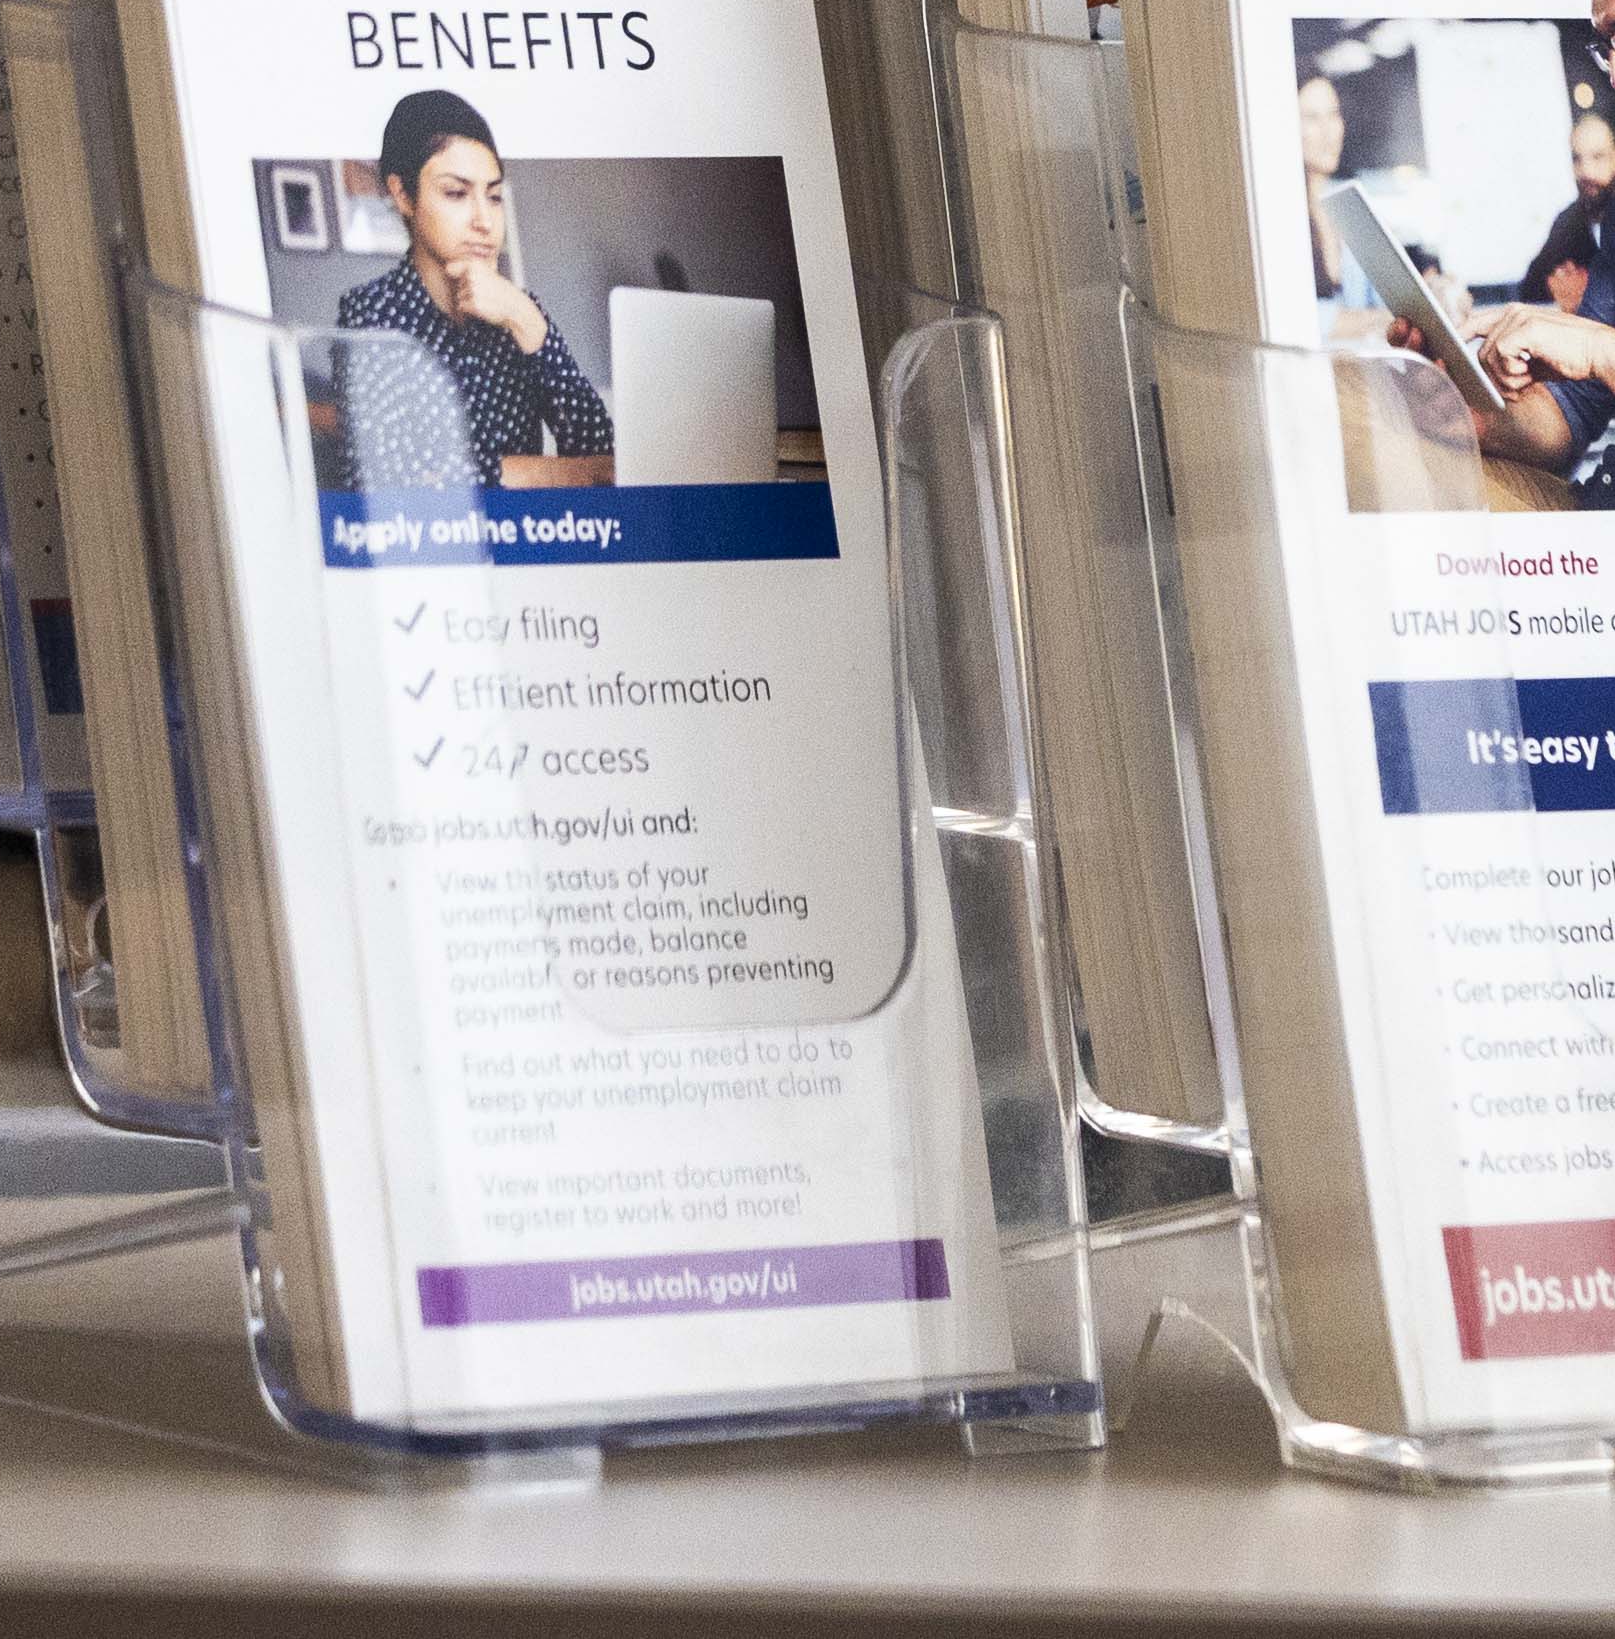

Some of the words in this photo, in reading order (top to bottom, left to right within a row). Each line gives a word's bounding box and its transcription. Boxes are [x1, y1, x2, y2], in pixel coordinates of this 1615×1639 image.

[347, 11, 656, 71] BENEFITS
[430, 510, 517, 544] onlne
[523, 510, 623, 550] today:
[1560, 549, 1599, 577] the
[521, 606, 600, 649] filing
[1391, 610, 1459, 637] UTAH
[1466, 609, 1522, 636] JOS
[1528, 607, 1604, 635] mobile
[587, 670, 772, 708] information
[543, 744, 650, 775] access
[1466, 727, 1518, 765] It's
[1525, 734, 1600, 771] easy
[434, 807, 634, 848] jobs.uth.gov/ui
[642, 808, 698, 836] and:
[504, 867, 540, 893] th
[544, 867, 619, 893] status
[627, 863, 651, 888] of
[656, 866, 710, 895] your
[1538, 868, 1584, 890] our
[623, 896, 692, 923] claim,
[699, 891, 809, 920] including
[568, 930, 643, 958] made,
[650, 927, 748, 952] balance
[1442, 920, 1502, 946] View
[573, 967, 598, 989] or
[605, 962, 700, 987] reasons
[708, 957, 835, 988] preventing
[1453, 977, 1496, 1004] Get
[570, 1044, 630, 1073] what
[639, 1046, 682, 1079] you
[756, 1039, 779, 1062] to
[788, 1032, 819, 1062] do
[830, 1035, 853, 1060] to
[1461, 1032, 1557, 1061] Connect
[593, 1072, 769, 1110] unemployment
[778, 1071, 842, 1097] claim
[1468, 1091, 1549, 1118] Create
[1555, 1096, 1570, 1114] a
[1478, 1148, 1559, 1175] Access
[1564, 1143, 1613, 1176] jobs
[547, 1166, 666, 1200] important
[584, 1203, 608, 1226] to
[616, 1199, 673, 1224] work
[682, 1195, 729, 1221] and
[570, 1261, 798, 1311] jobs.utah.gov/ui
